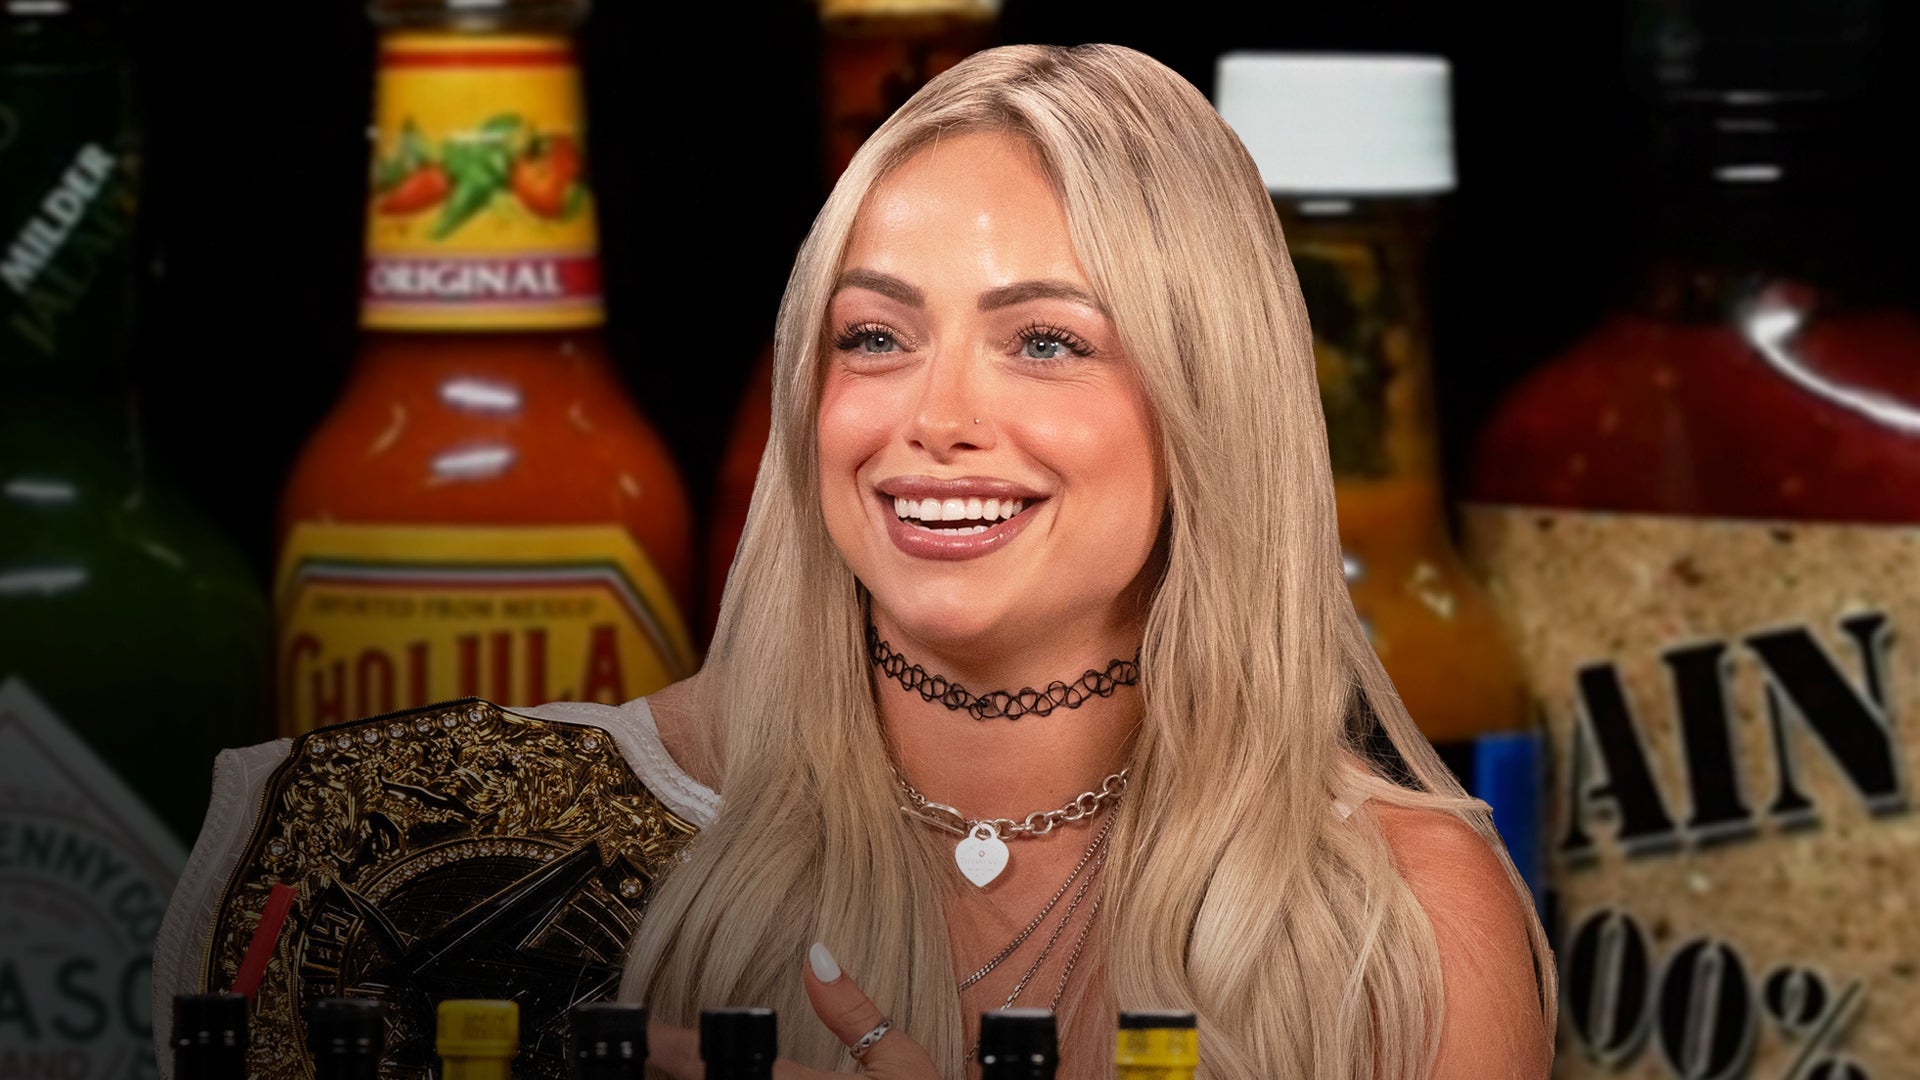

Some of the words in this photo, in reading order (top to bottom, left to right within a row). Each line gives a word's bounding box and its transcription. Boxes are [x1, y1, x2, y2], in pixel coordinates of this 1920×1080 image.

[0, 141, 116, 296] MILDER
[368, 261, 563, 298] ORIGINAL
[1560, 612, 1903, 852] AIN
[1566, 908, 1872, 1080] 00%
